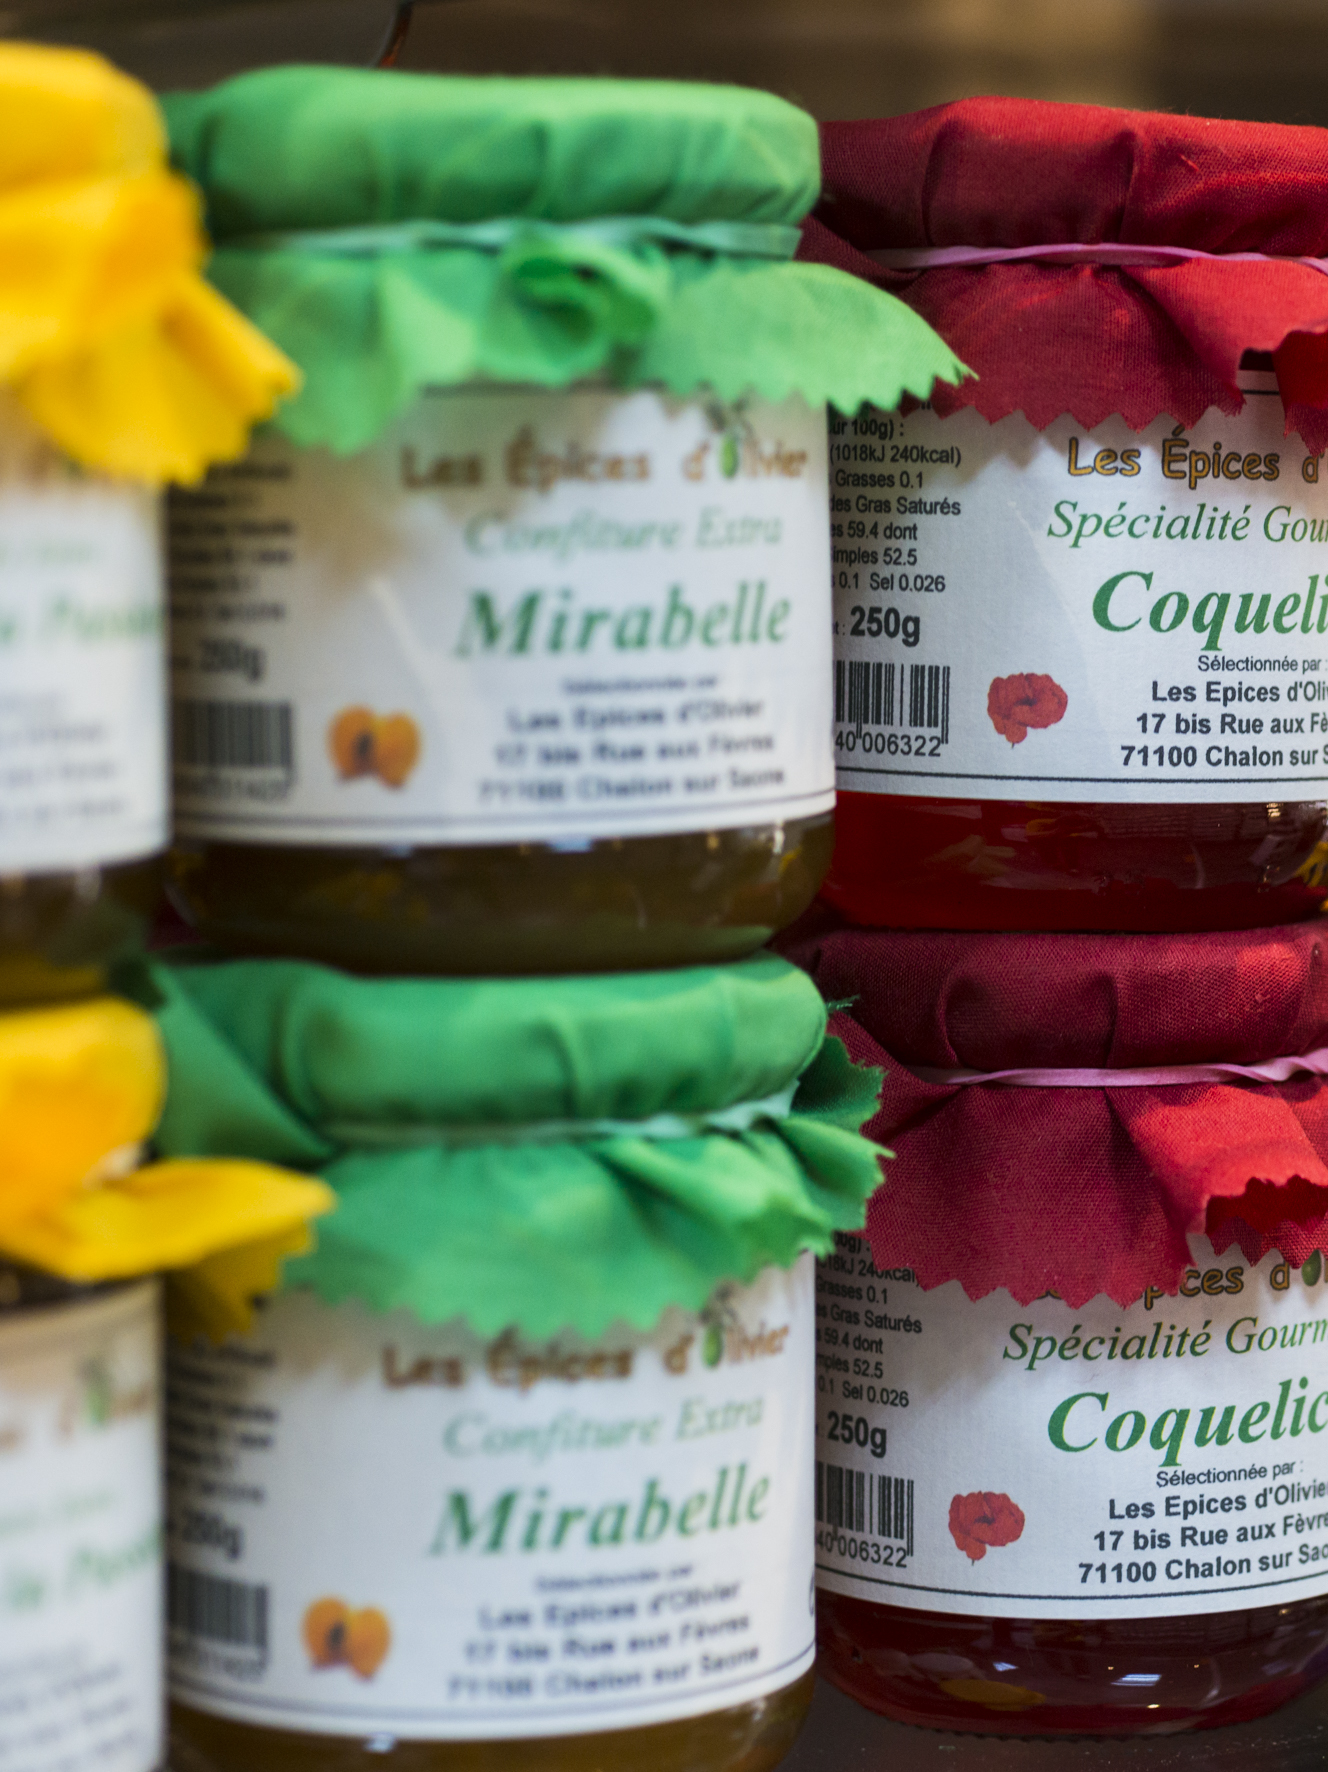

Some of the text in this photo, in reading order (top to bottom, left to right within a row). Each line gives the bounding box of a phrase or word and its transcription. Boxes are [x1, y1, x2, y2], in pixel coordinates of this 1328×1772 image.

[832, 420, 848, 436] ur
[830, 444, 962, 468] (1018kJ 240kcal)
[1068, 436, 1141, 477] Les
[1161, 424, 1280, 490] Épices
[835, 469, 923, 489] Grasses 0.1
[855, 494, 892, 514] Gras
[896, 496, 961, 516] Saturés
[847, 520, 879, 540] 59.4
[883, 522, 918, 541] dont
[1047, 500, 1251, 548] Spécialité
[833, 546, 917, 567] imples 52.5
[838, 571, 946, 592] 0.1 Sel 0.026
[452, 579, 792, 660] Mirabelle
[850, 605, 921, 647] 250g
[1197, 654, 1298, 672] Sélectionnée
[1302, 657, 1321, 675] par
[1152, 680, 1196, 702] Les
[1206, 680, 1280, 707] Epices
[1136, 712, 1166, 734] 17
[1175, 712, 1211, 734] bis
[1220, 713, 1263, 734] Rue
[1270, 716, 1305, 734] aux
[1121, 745, 1197, 767] 71100
[1205, 745, 1283, 767] Chalon
[1289, 749, 1318, 766] sur
[867, 1285, 888, 1304] 0.1
[830, 1304, 860, 1325] Gras
[864, 1310, 922, 1333] Saturés
[824, 1329, 883, 1354] 59.4 dont
[1003, 1319, 1213, 1371] Spécialité
[853, 1358, 883, 1379] 52.5
[818, 1376, 909, 1407] 0.1 Sel 0.026
[442, 1397, 764, 1467] Confiture Extra
[827, 1411, 886, 1458] 250g
[1156, 1464, 1267, 1488] Sélectionnée
[1272, 1460, 1295, 1480] par
[426, 1462, 771, 1558] Mirabelle
[1109, 1498, 1155, 1520] Les
[1165, 1494, 1246, 1520] Epices
[1094, 1530, 1124, 1551] 17
[1134, 1528, 1171, 1551] bis
[1181, 1525, 1228, 1547] Rue
[1236, 1521, 1276, 1542] aux
[1078, 1561, 1156, 1584] 71100
[1165, 1556, 1251, 1580] Chalon
[1258, 1550, 1293, 1571] sur
